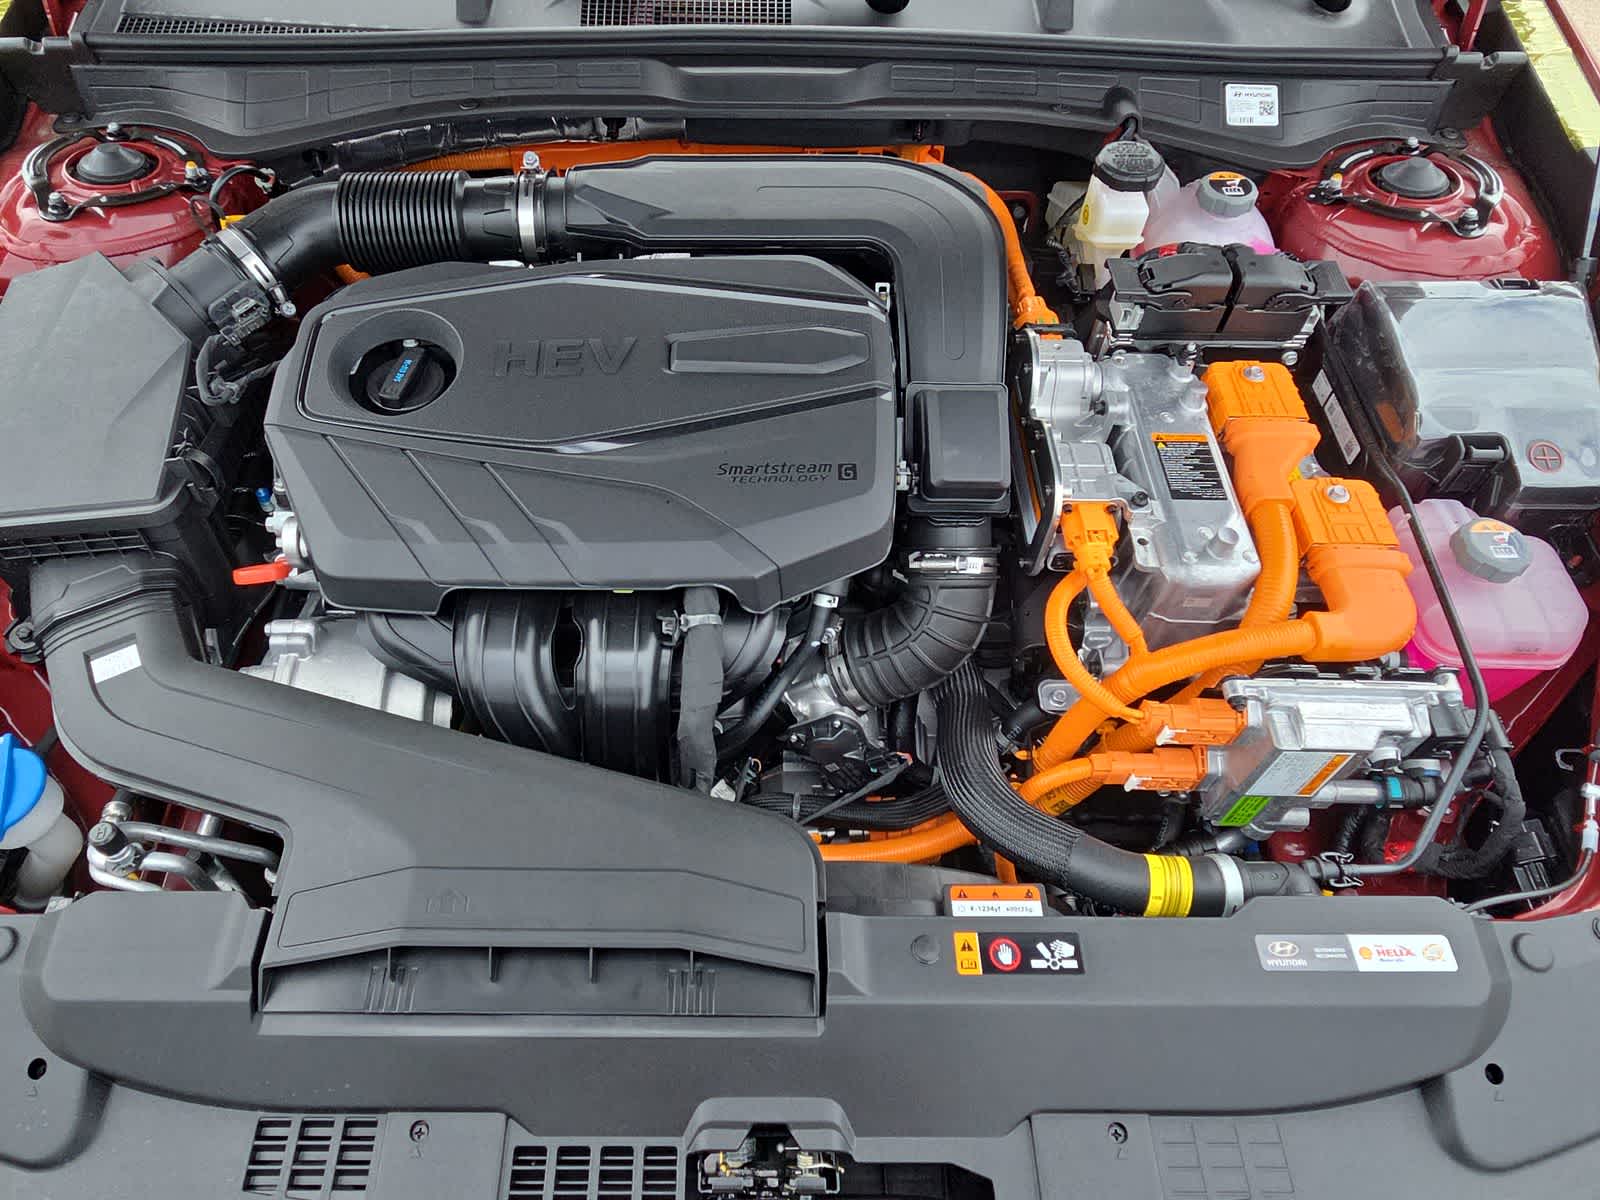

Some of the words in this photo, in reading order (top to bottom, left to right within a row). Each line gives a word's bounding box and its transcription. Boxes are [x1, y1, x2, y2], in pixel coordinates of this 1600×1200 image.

[494, 338, 639, 377] HEV
[716, 462, 833, 476] Smartstream
[730, 474, 830, 484] TECHNOLOGY
[1376, 946, 1416, 957] HELIX
[1267, 959, 1308, 967] HYUNDAI
